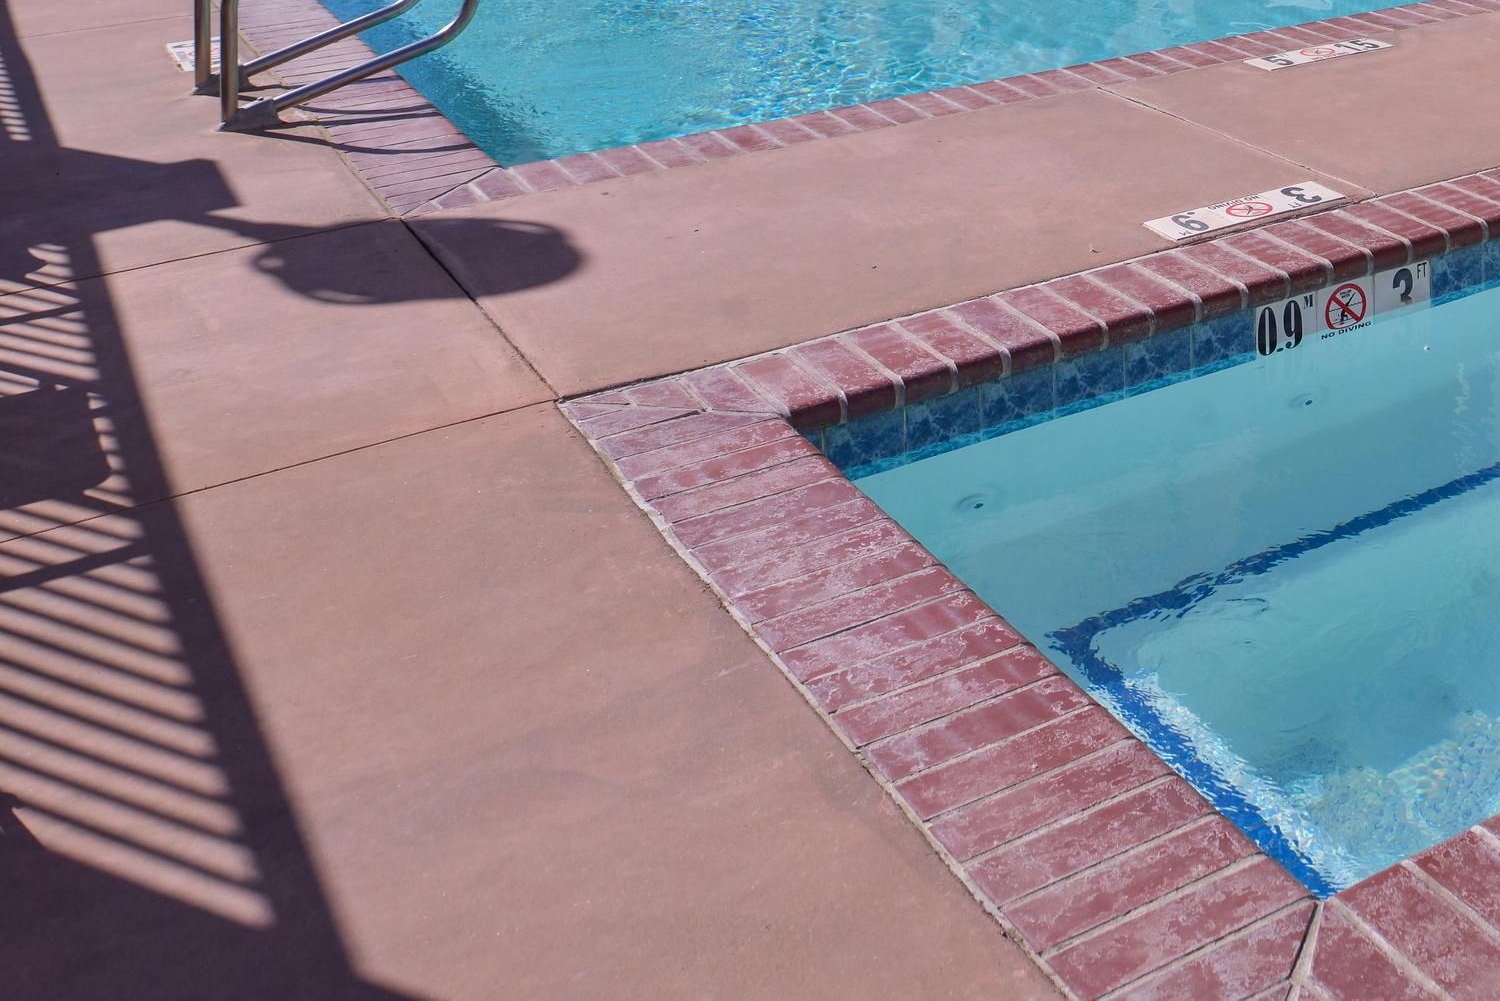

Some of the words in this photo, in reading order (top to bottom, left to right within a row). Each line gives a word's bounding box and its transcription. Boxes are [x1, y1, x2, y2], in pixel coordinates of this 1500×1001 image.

[1262, 55, 1294, 66] 5
[1245, 194, 1260, 202] NO
[1280, 186, 1322, 204] 3
[1207, 197, 1245, 211] DIVING
[1287, 200, 1303, 209] FT
[1416, 261, 1428, 280] FT
[1257, 299, 1303, 357] 0.9
[1303, 293, 1314, 310] M
[1321, 330, 1336, 340] NO
[1338, 319, 1372, 335] DIVING
